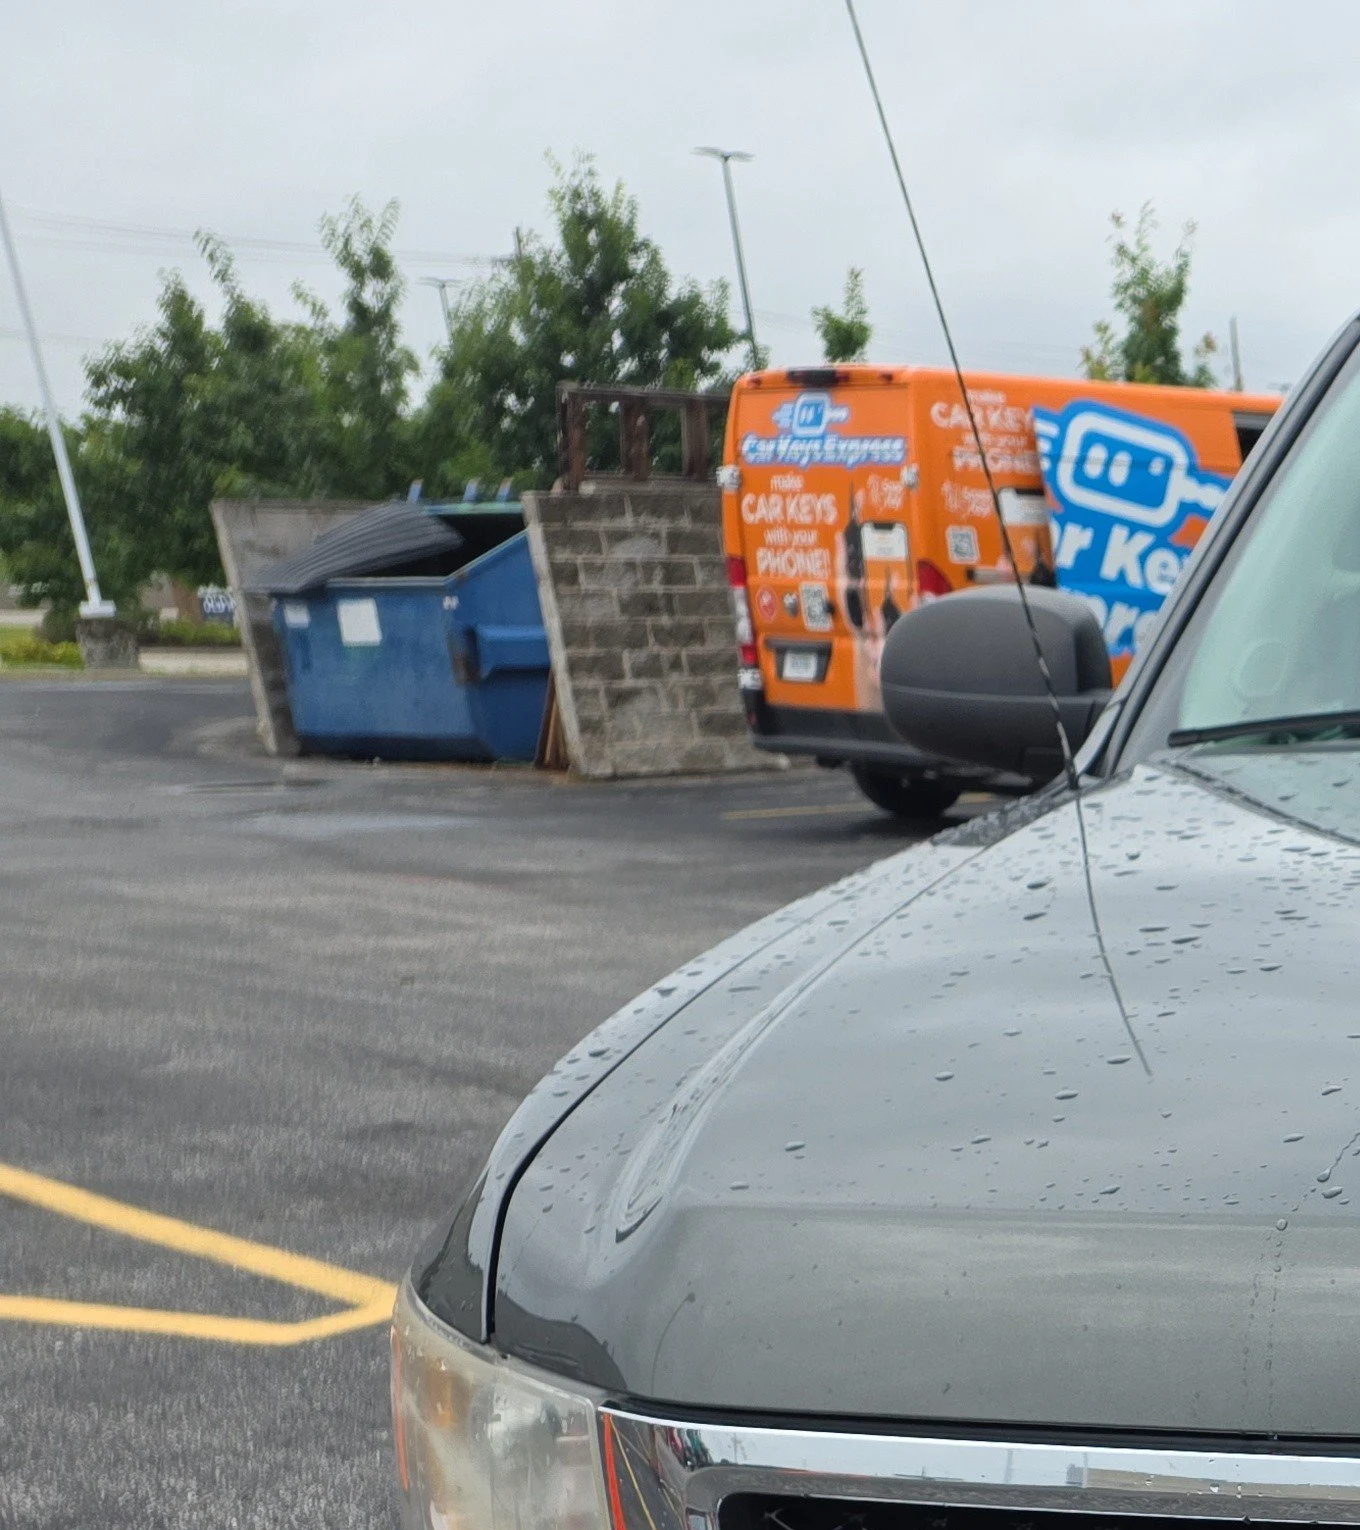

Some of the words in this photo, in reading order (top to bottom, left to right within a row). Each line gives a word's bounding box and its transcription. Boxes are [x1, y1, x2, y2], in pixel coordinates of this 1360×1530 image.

[741, 433, 776, 464] Car
[776, 434, 823, 471] Keys
[823, 435, 905, 472] Express
[741, 493, 784, 525] CAR
[785, 493, 839, 526] KEYS
